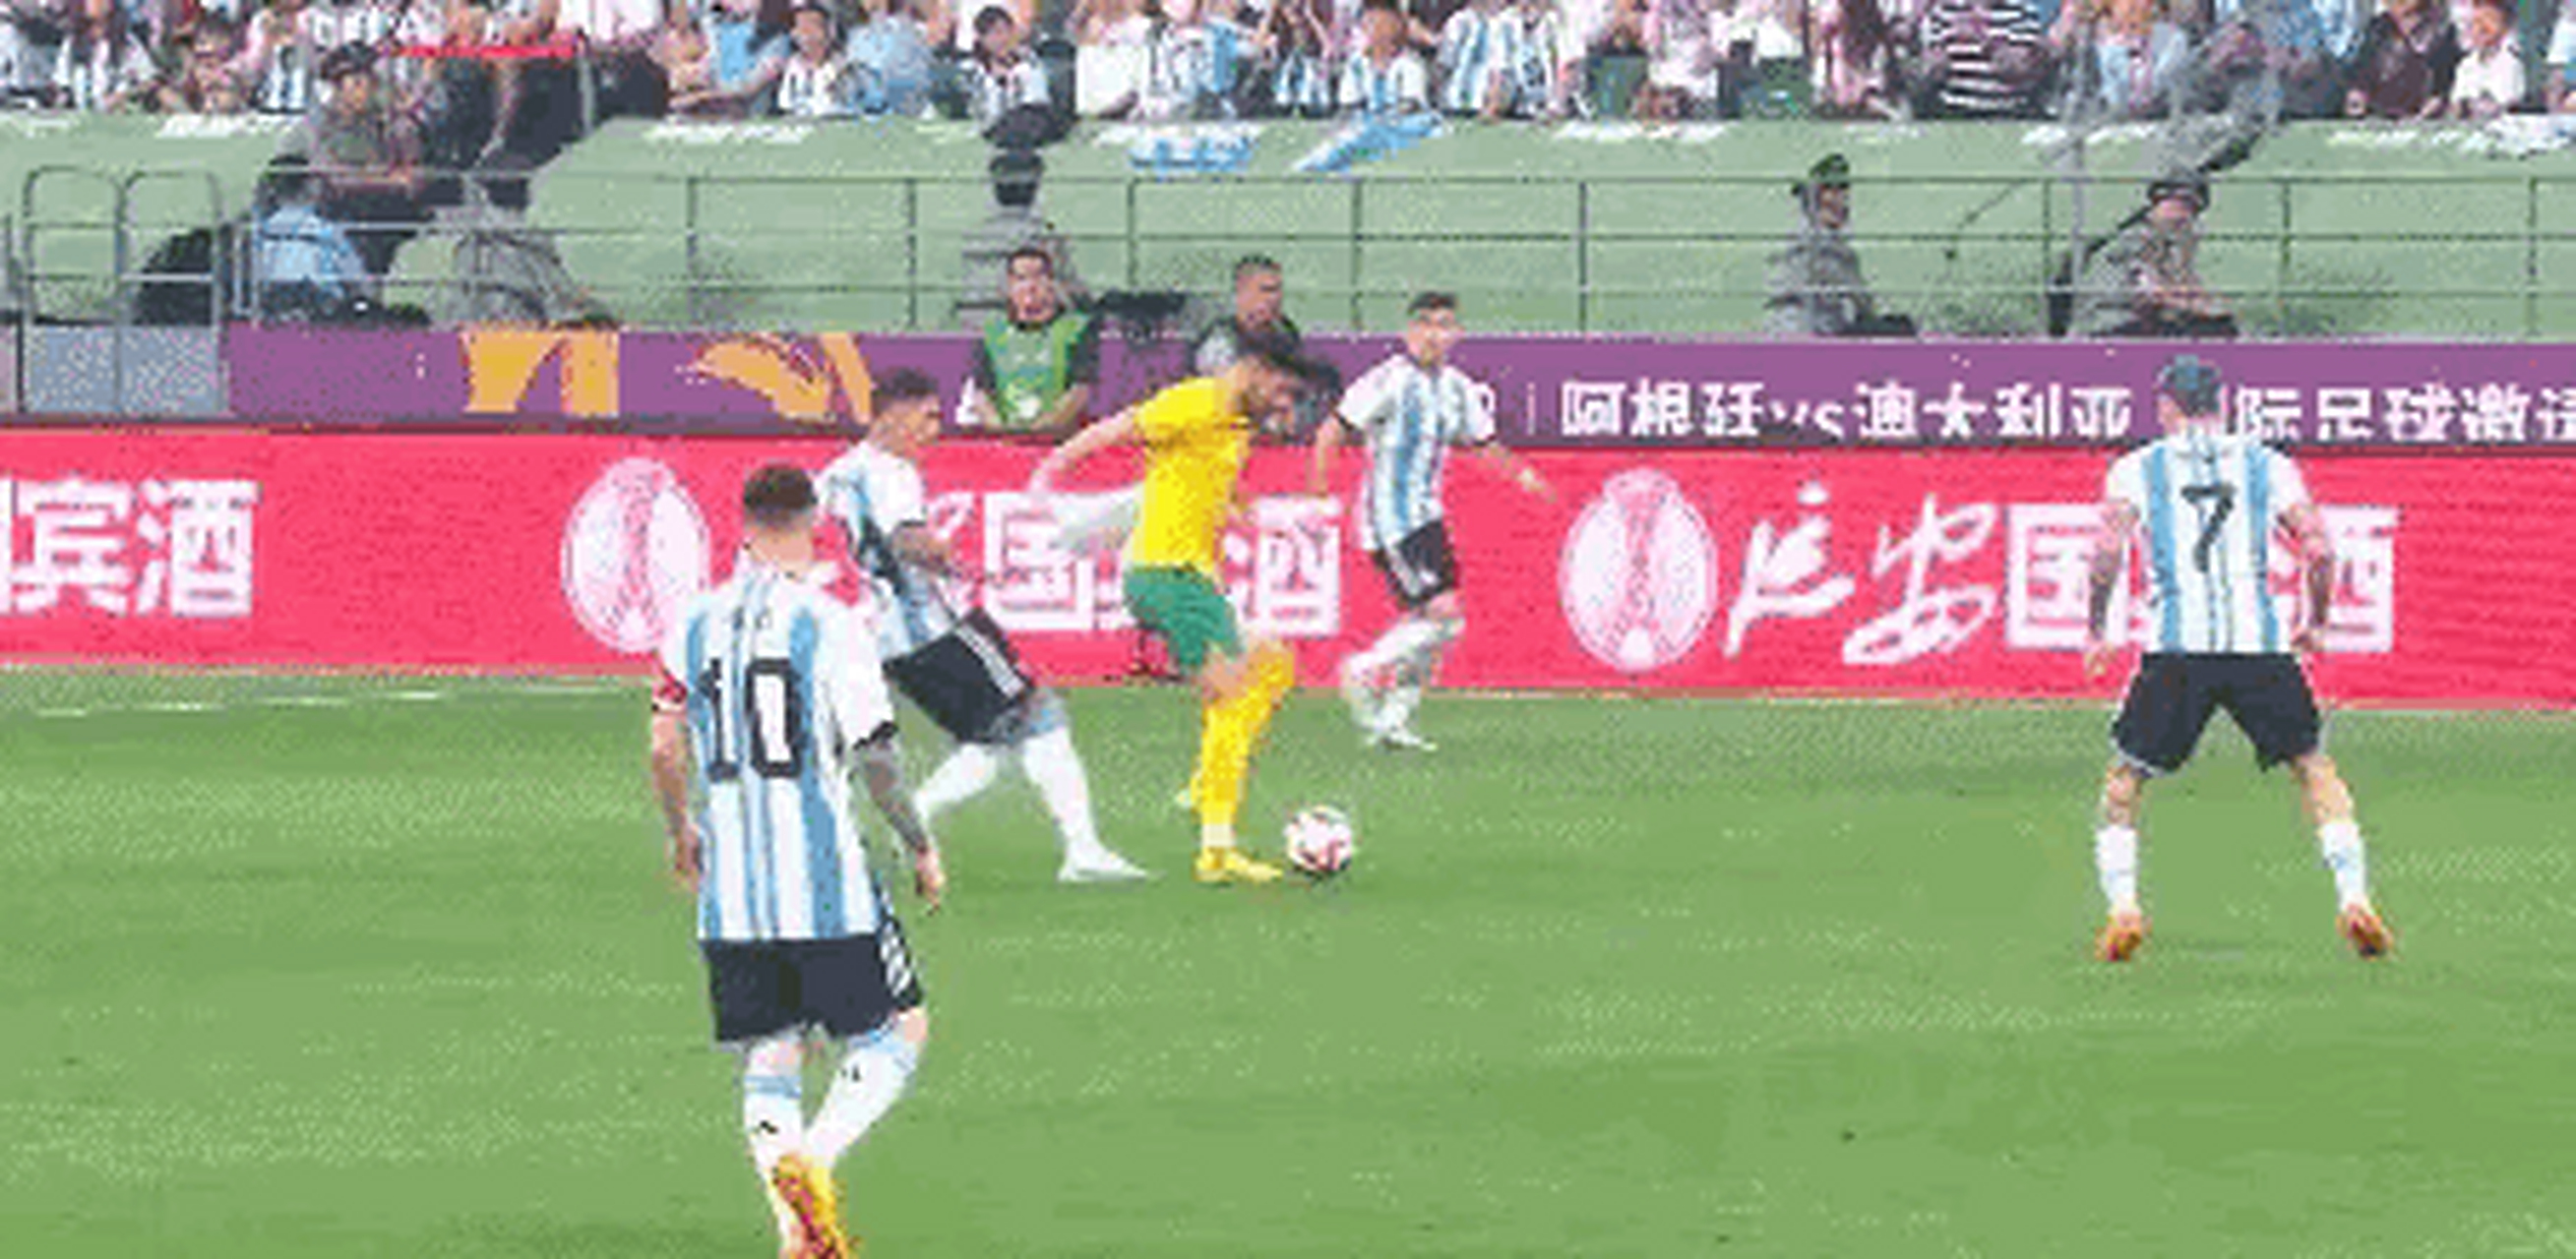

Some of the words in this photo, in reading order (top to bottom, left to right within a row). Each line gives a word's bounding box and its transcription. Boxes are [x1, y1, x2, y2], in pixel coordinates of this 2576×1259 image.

[0, 478, 259, 617] 宾酒
[2179, 482, 2238, 573] 7
[695, 657, 803, 783] 10
